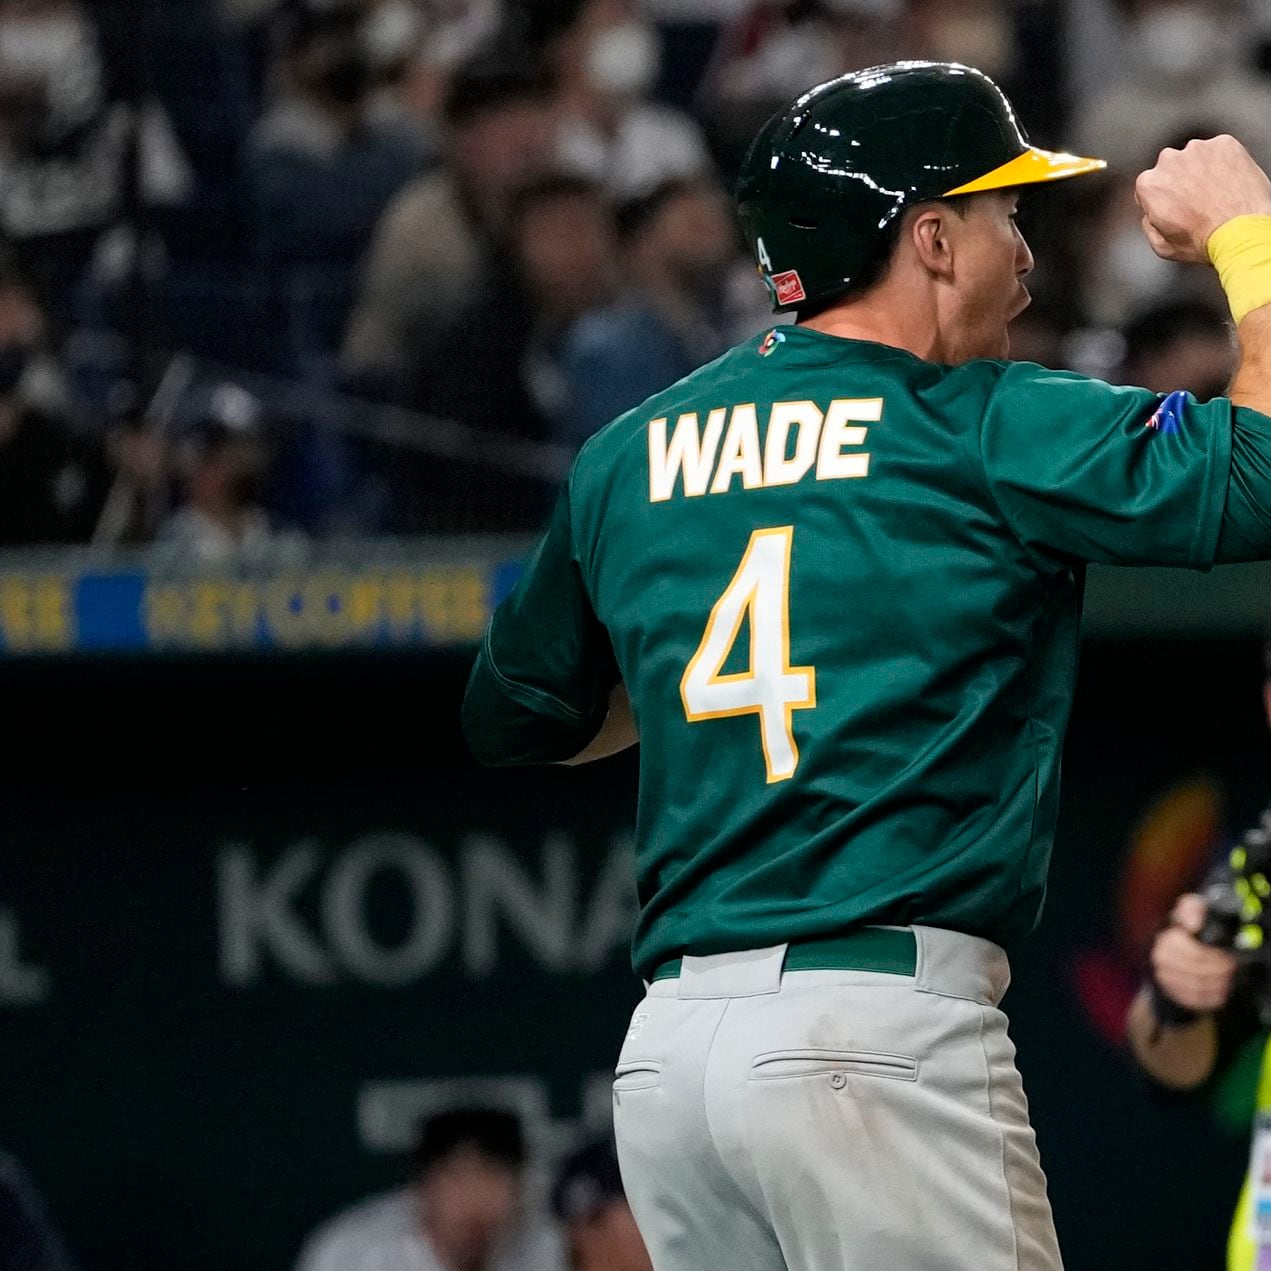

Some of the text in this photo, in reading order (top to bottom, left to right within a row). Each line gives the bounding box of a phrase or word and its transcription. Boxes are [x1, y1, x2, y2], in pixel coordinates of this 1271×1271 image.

[756, 236, 773, 272] 4
[648, 398, 884, 503] WADE
[680, 526, 816, 783] 4
